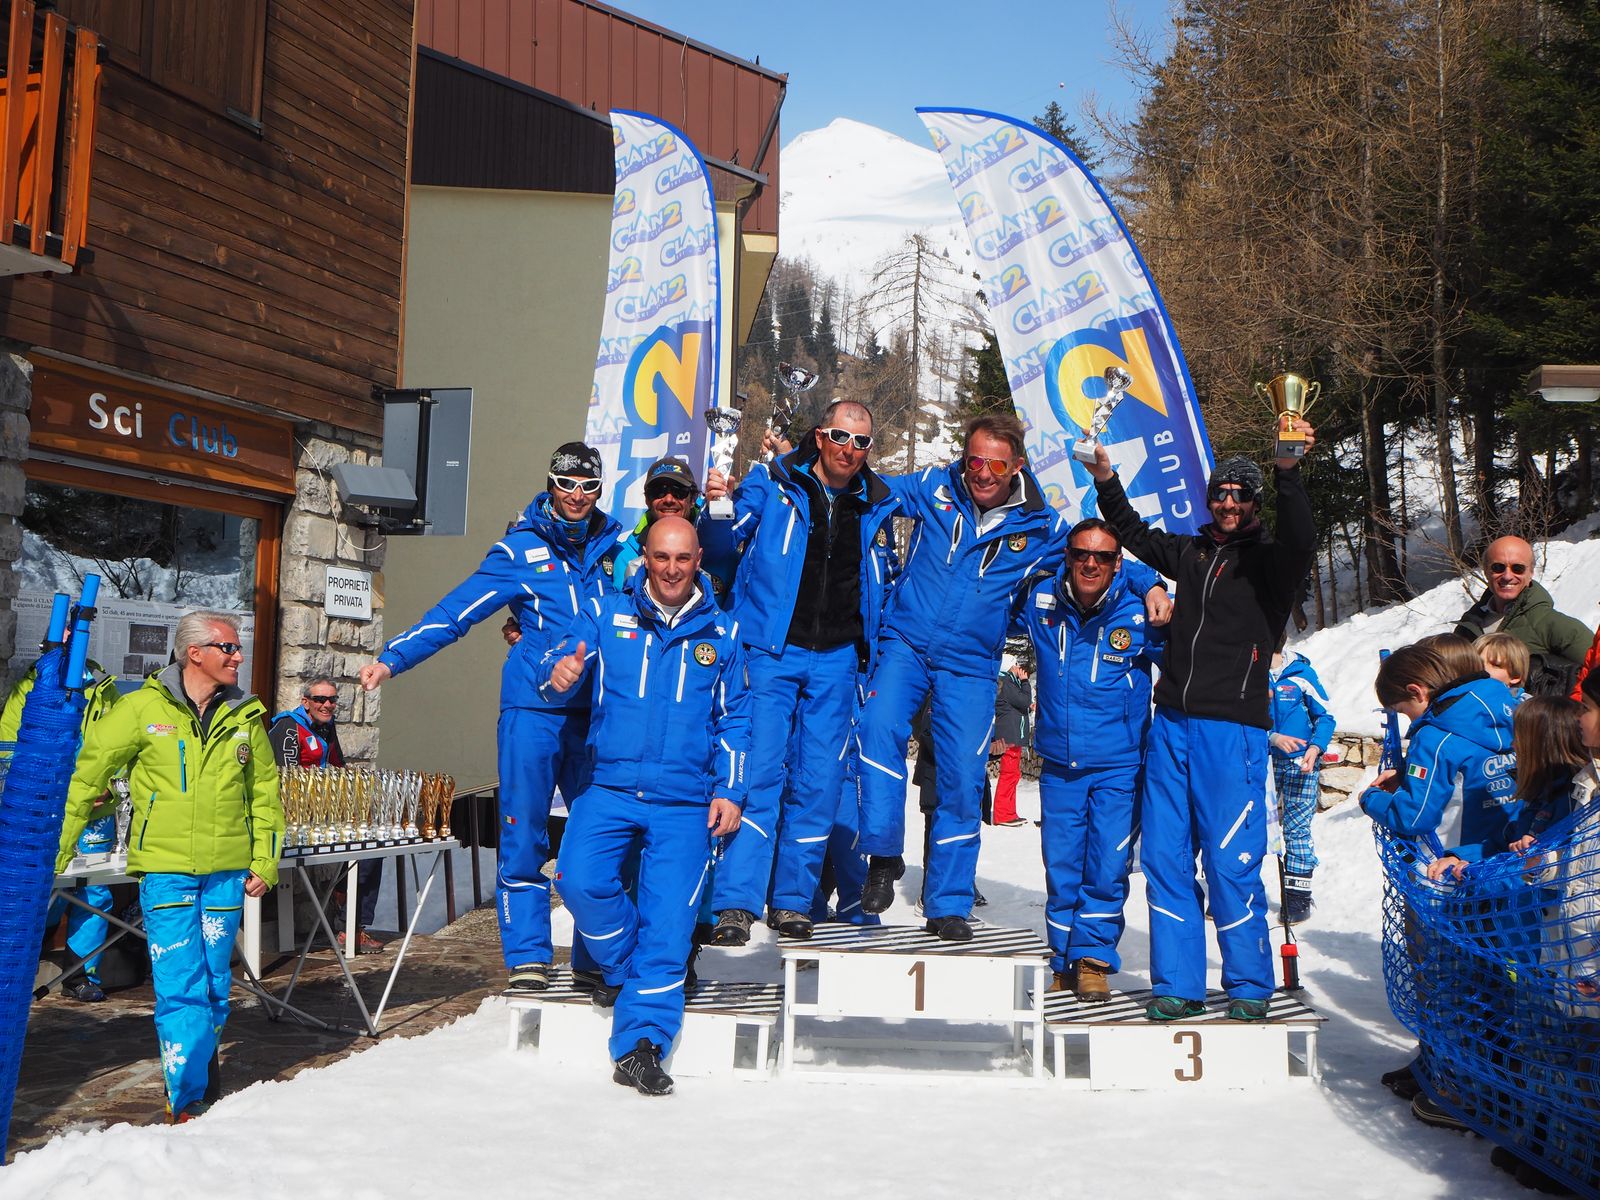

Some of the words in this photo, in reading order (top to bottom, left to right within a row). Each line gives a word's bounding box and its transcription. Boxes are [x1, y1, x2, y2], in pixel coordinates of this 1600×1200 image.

[613, 201, 682, 253] CLAN2
[975, 195, 1068, 261] CLAN2
[615, 273, 687, 323] CLAN2
[1012, 270, 1110, 335] CLAN2
[89, 393, 142, 438] Sci
[168, 412, 238, 458] Club
[1153, 429, 1193, 519] CLUB
[334, 594, 363, 608] PRIVATA
[503, 891, 511, 924] DESCENTE
[907, 961, 926, 1012] 1
[1173, 1030, 1203, 1082] 3
